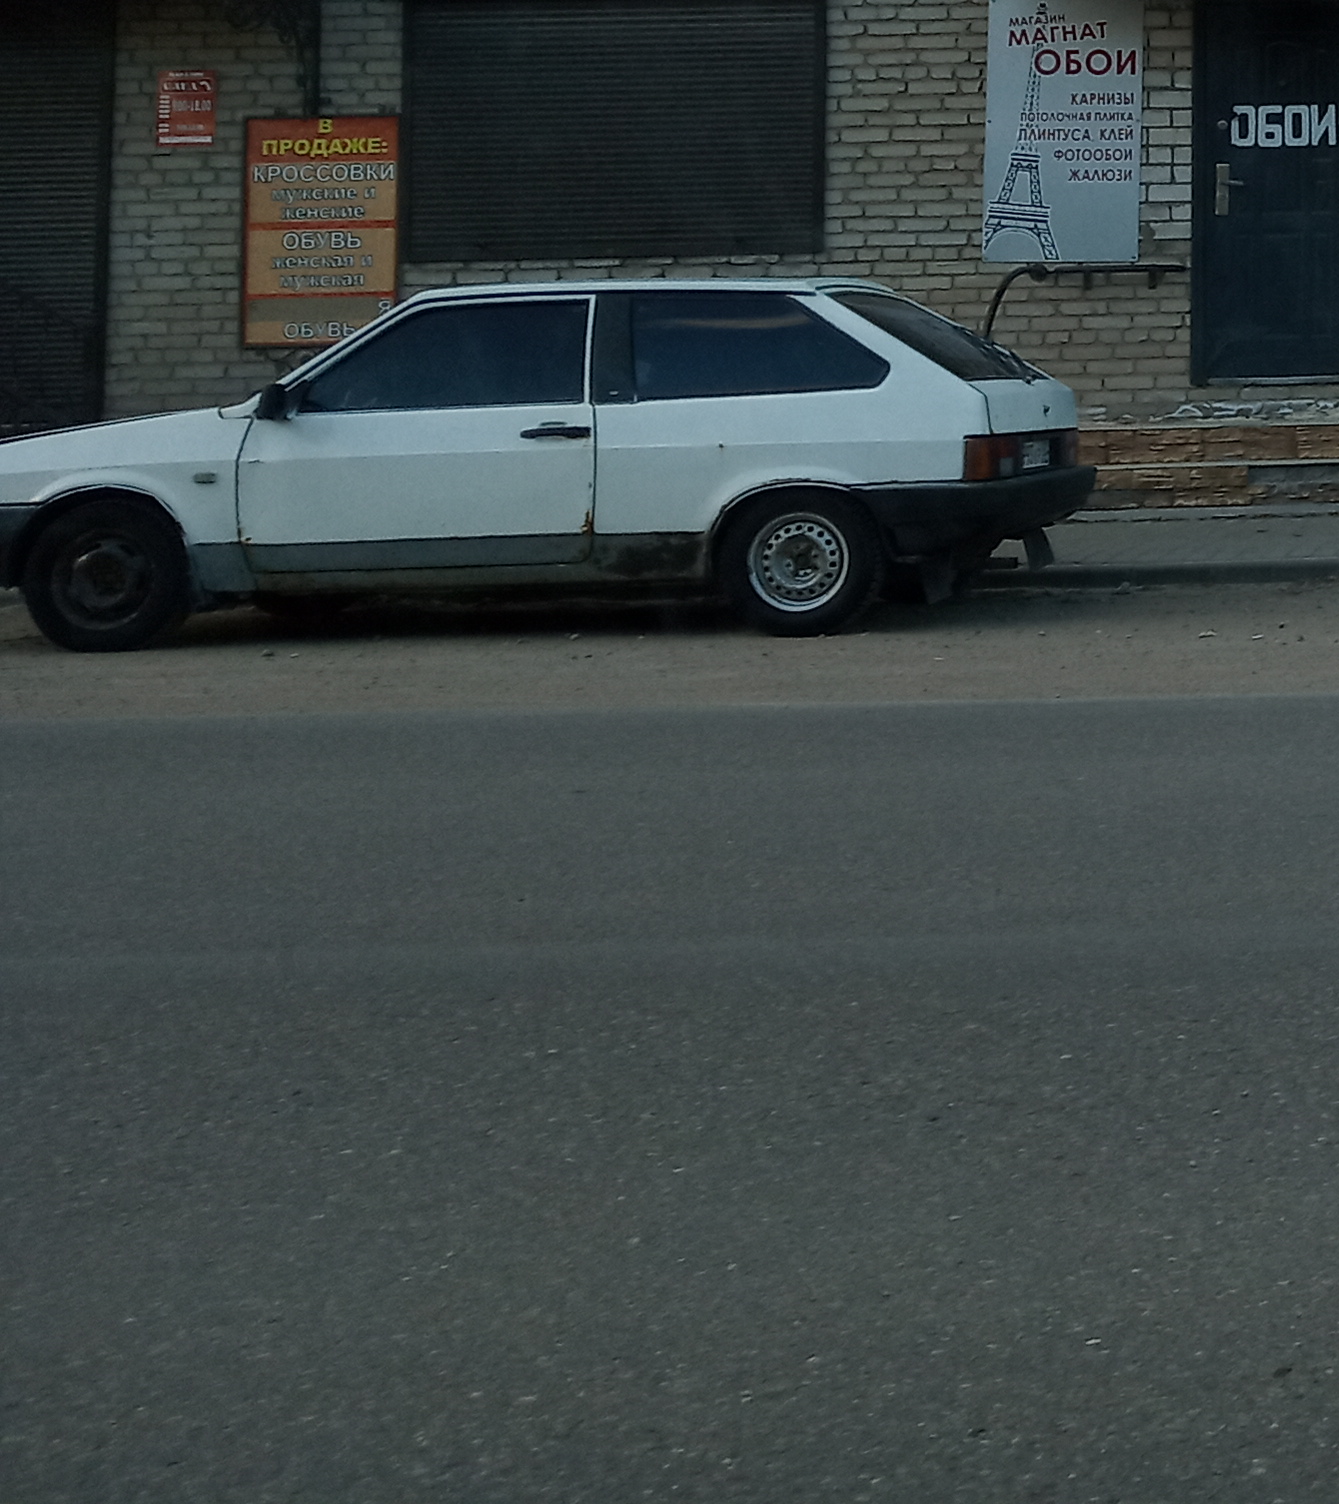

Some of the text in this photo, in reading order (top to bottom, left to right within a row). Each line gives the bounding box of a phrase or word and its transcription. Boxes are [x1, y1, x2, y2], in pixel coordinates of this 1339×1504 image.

[1008, 14, 1065, 27] МАГАЗИН
[1008, 21, 1107, 46] МАГНАТ
[1034, 49, 1136, 75] ОБОИ
[1070, 92, 1134, 105] КАРНИЗЫ
[1020, 112, 1134, 122] ПОТОЛОЧНАЯ ПЛИТКА
[318, 119, 333, 134] В
[1100, 125, 1133, 141] КЛЕЙ
[1231, 104, 1336, 147] ОБОИ
[262, 138, 388, 157] ПРОДАЖЕ:
[1054, 149, 1132, 162] ФОТООБОИ
[253, 164, 395, 183] КРОССОВКИ
[1068, 169, 1132, 182] ЖАЛЮЗИ
[272, 187, 376, 204] мужские и
[281, 206, 365, 220] женские
[283, 231, 361, 250] ОБУВЬ
[271, 255, 372, 269] женская и
[279, 274, 364, 290] мужская
[284, 322, 355, 339] ОБУВЬ
